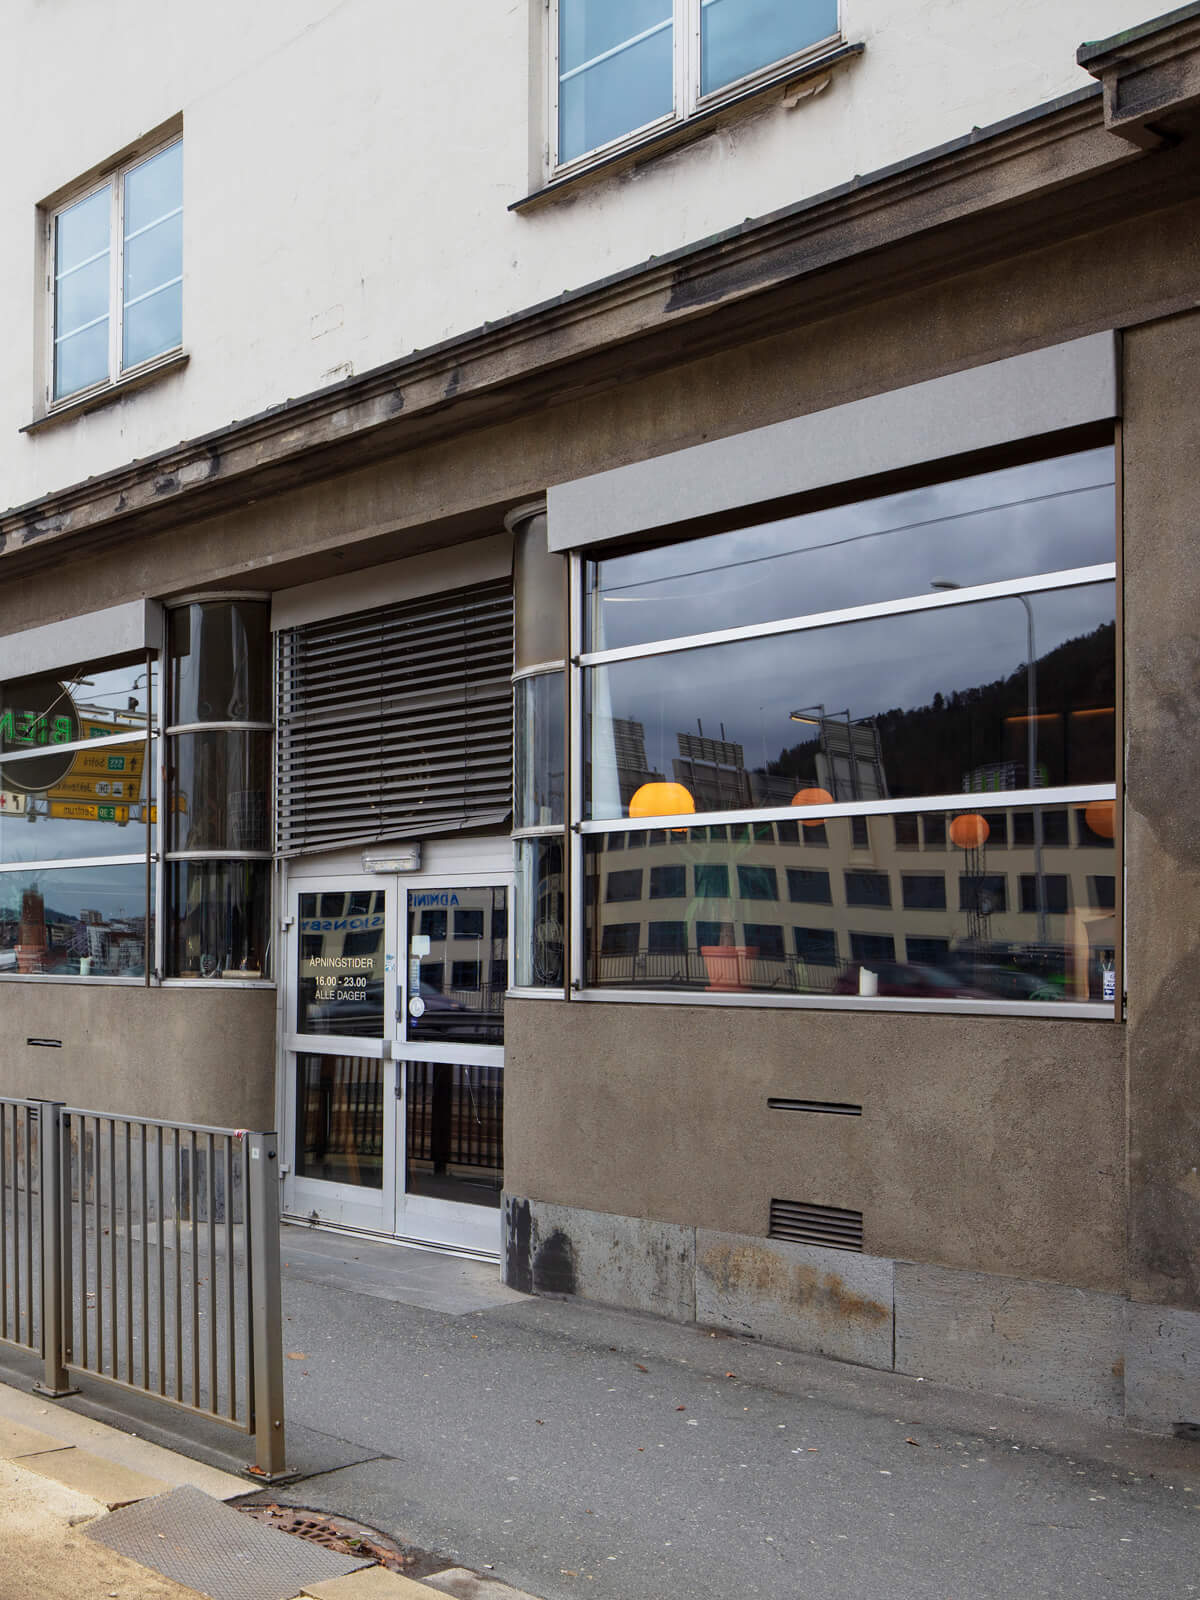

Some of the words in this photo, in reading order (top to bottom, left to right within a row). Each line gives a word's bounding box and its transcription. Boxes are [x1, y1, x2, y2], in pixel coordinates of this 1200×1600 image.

[309, 955, 374, 968] ÅPNINGSTIDER
[315, 976, 336, 986] 16.00
[343, 976, 367, 987] 23.00
[315, 990, 335, 1000] ALLE
[337, 990, 366, 1000] DAGER
